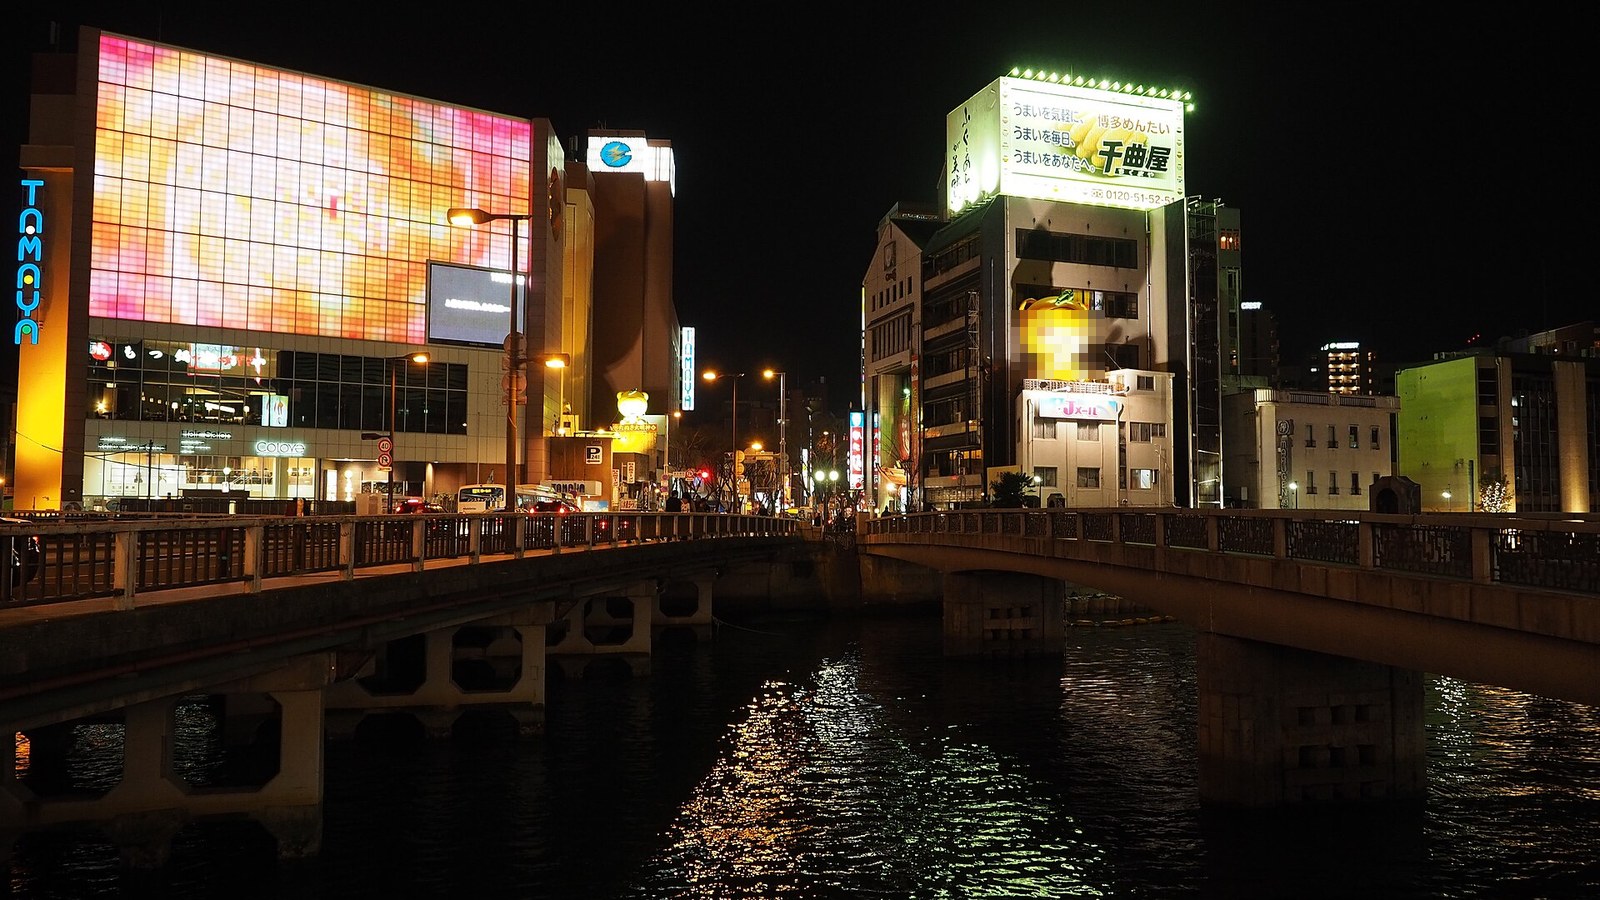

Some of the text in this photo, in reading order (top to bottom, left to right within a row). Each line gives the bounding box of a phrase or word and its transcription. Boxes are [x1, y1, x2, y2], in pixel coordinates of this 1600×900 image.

[1013, 102, 1084, 124] うまいを気軽に、
[1098, 114, 1170, 134] 博多めんたい
[1013, 125, 1076, 146] うまいを毎日、
[1013, 149, 1096, 172] うまいをあなたへ。
[1099, 141, 1171, 173] 千曲屋
[14, 180, 45, 345] TAMAYA
[684, 330, 693, 408] TAMAYA
[587, 447, 600, 459] P
